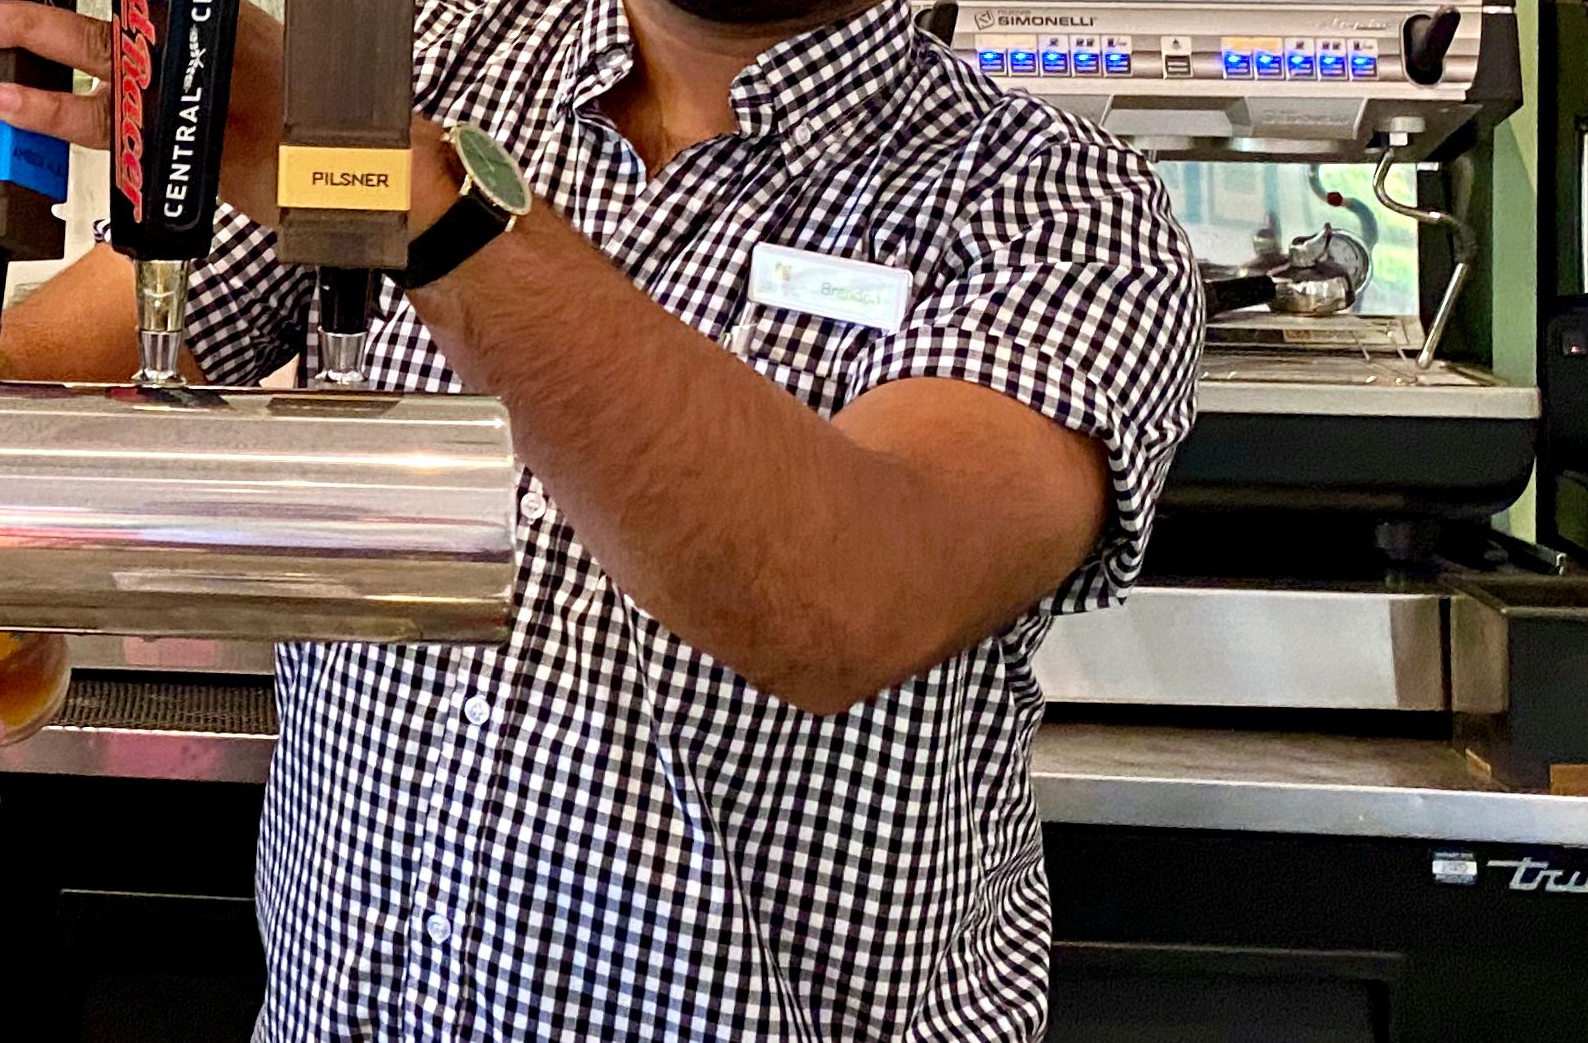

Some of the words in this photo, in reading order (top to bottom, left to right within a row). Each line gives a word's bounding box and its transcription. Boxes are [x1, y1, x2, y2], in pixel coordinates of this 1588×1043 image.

[998, 16, 1095, 27] SIMONELLI
[164, 86, 204, 219] CENTRAL
[312, 171, 389, 188] PILSNER
